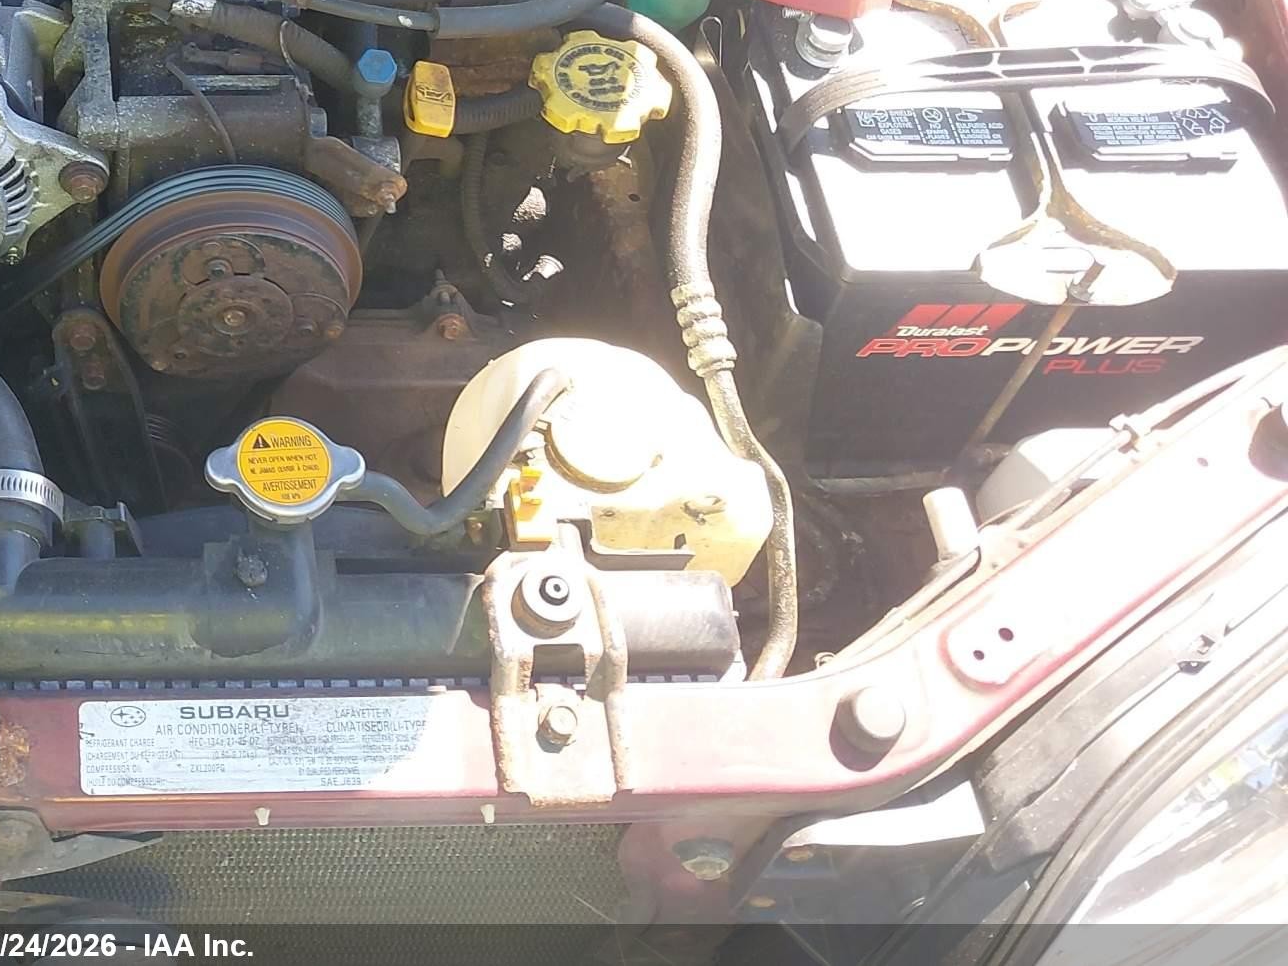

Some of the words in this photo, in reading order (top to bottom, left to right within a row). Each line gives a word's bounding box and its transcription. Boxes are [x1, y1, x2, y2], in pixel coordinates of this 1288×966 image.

[896, 325, 989, 337] Duralast
[1043, 358, 1167, 375] PLUS
[270, 435, 312, 448] WARNING
[248, 456, 268, 465] NEVER
[269, 455, 286, 464] OPEN
[286, 454, 304, 463] WHEN
[262, 479, 317, 492] AVERTISSEMENT
[180, 705, 289, 719] SUBARU
[156, 724, 173, 735] AIR
[321, 777, 337, 786] SAE
